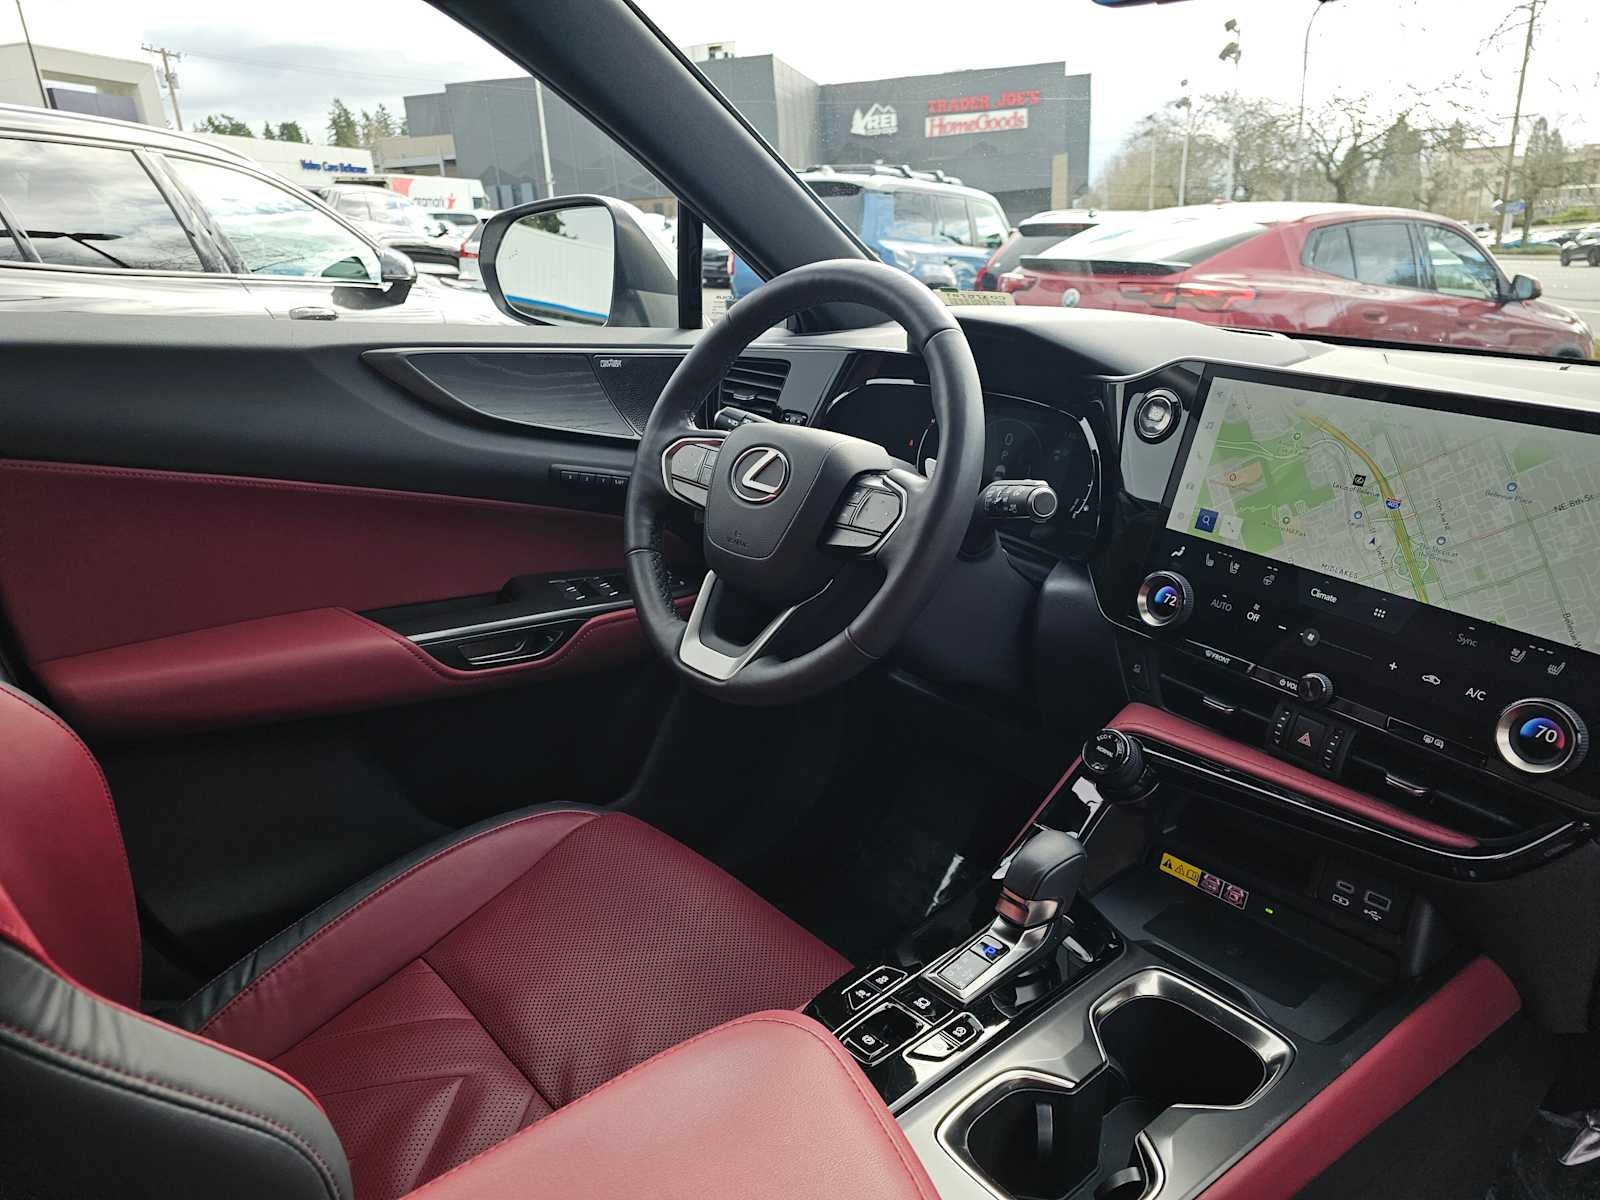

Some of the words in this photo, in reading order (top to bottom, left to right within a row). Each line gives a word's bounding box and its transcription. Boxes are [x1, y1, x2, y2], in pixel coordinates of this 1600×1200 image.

[928, 97, 989, 113] TRADER
[997, 90, 1040, 107] JOE'S
[866, 114, 897, 129] REI
[929, 112, 1025, 137] HomeGoods
[1552, 502, 1569, 513] NE
[1163, 593, 1178, 607] 72
[1310, 588, 1338, 604] Climate
[1210, 600, 1232, 612] AUTO
[1246, 611, 1261, 623] Off
[1457, 633, 1478, 647] Sync
[1211, 652, 1231, 665] FRONT
[1464, 687, 1487, 701] A/C
[1535, 724, 1558, 743] 70
